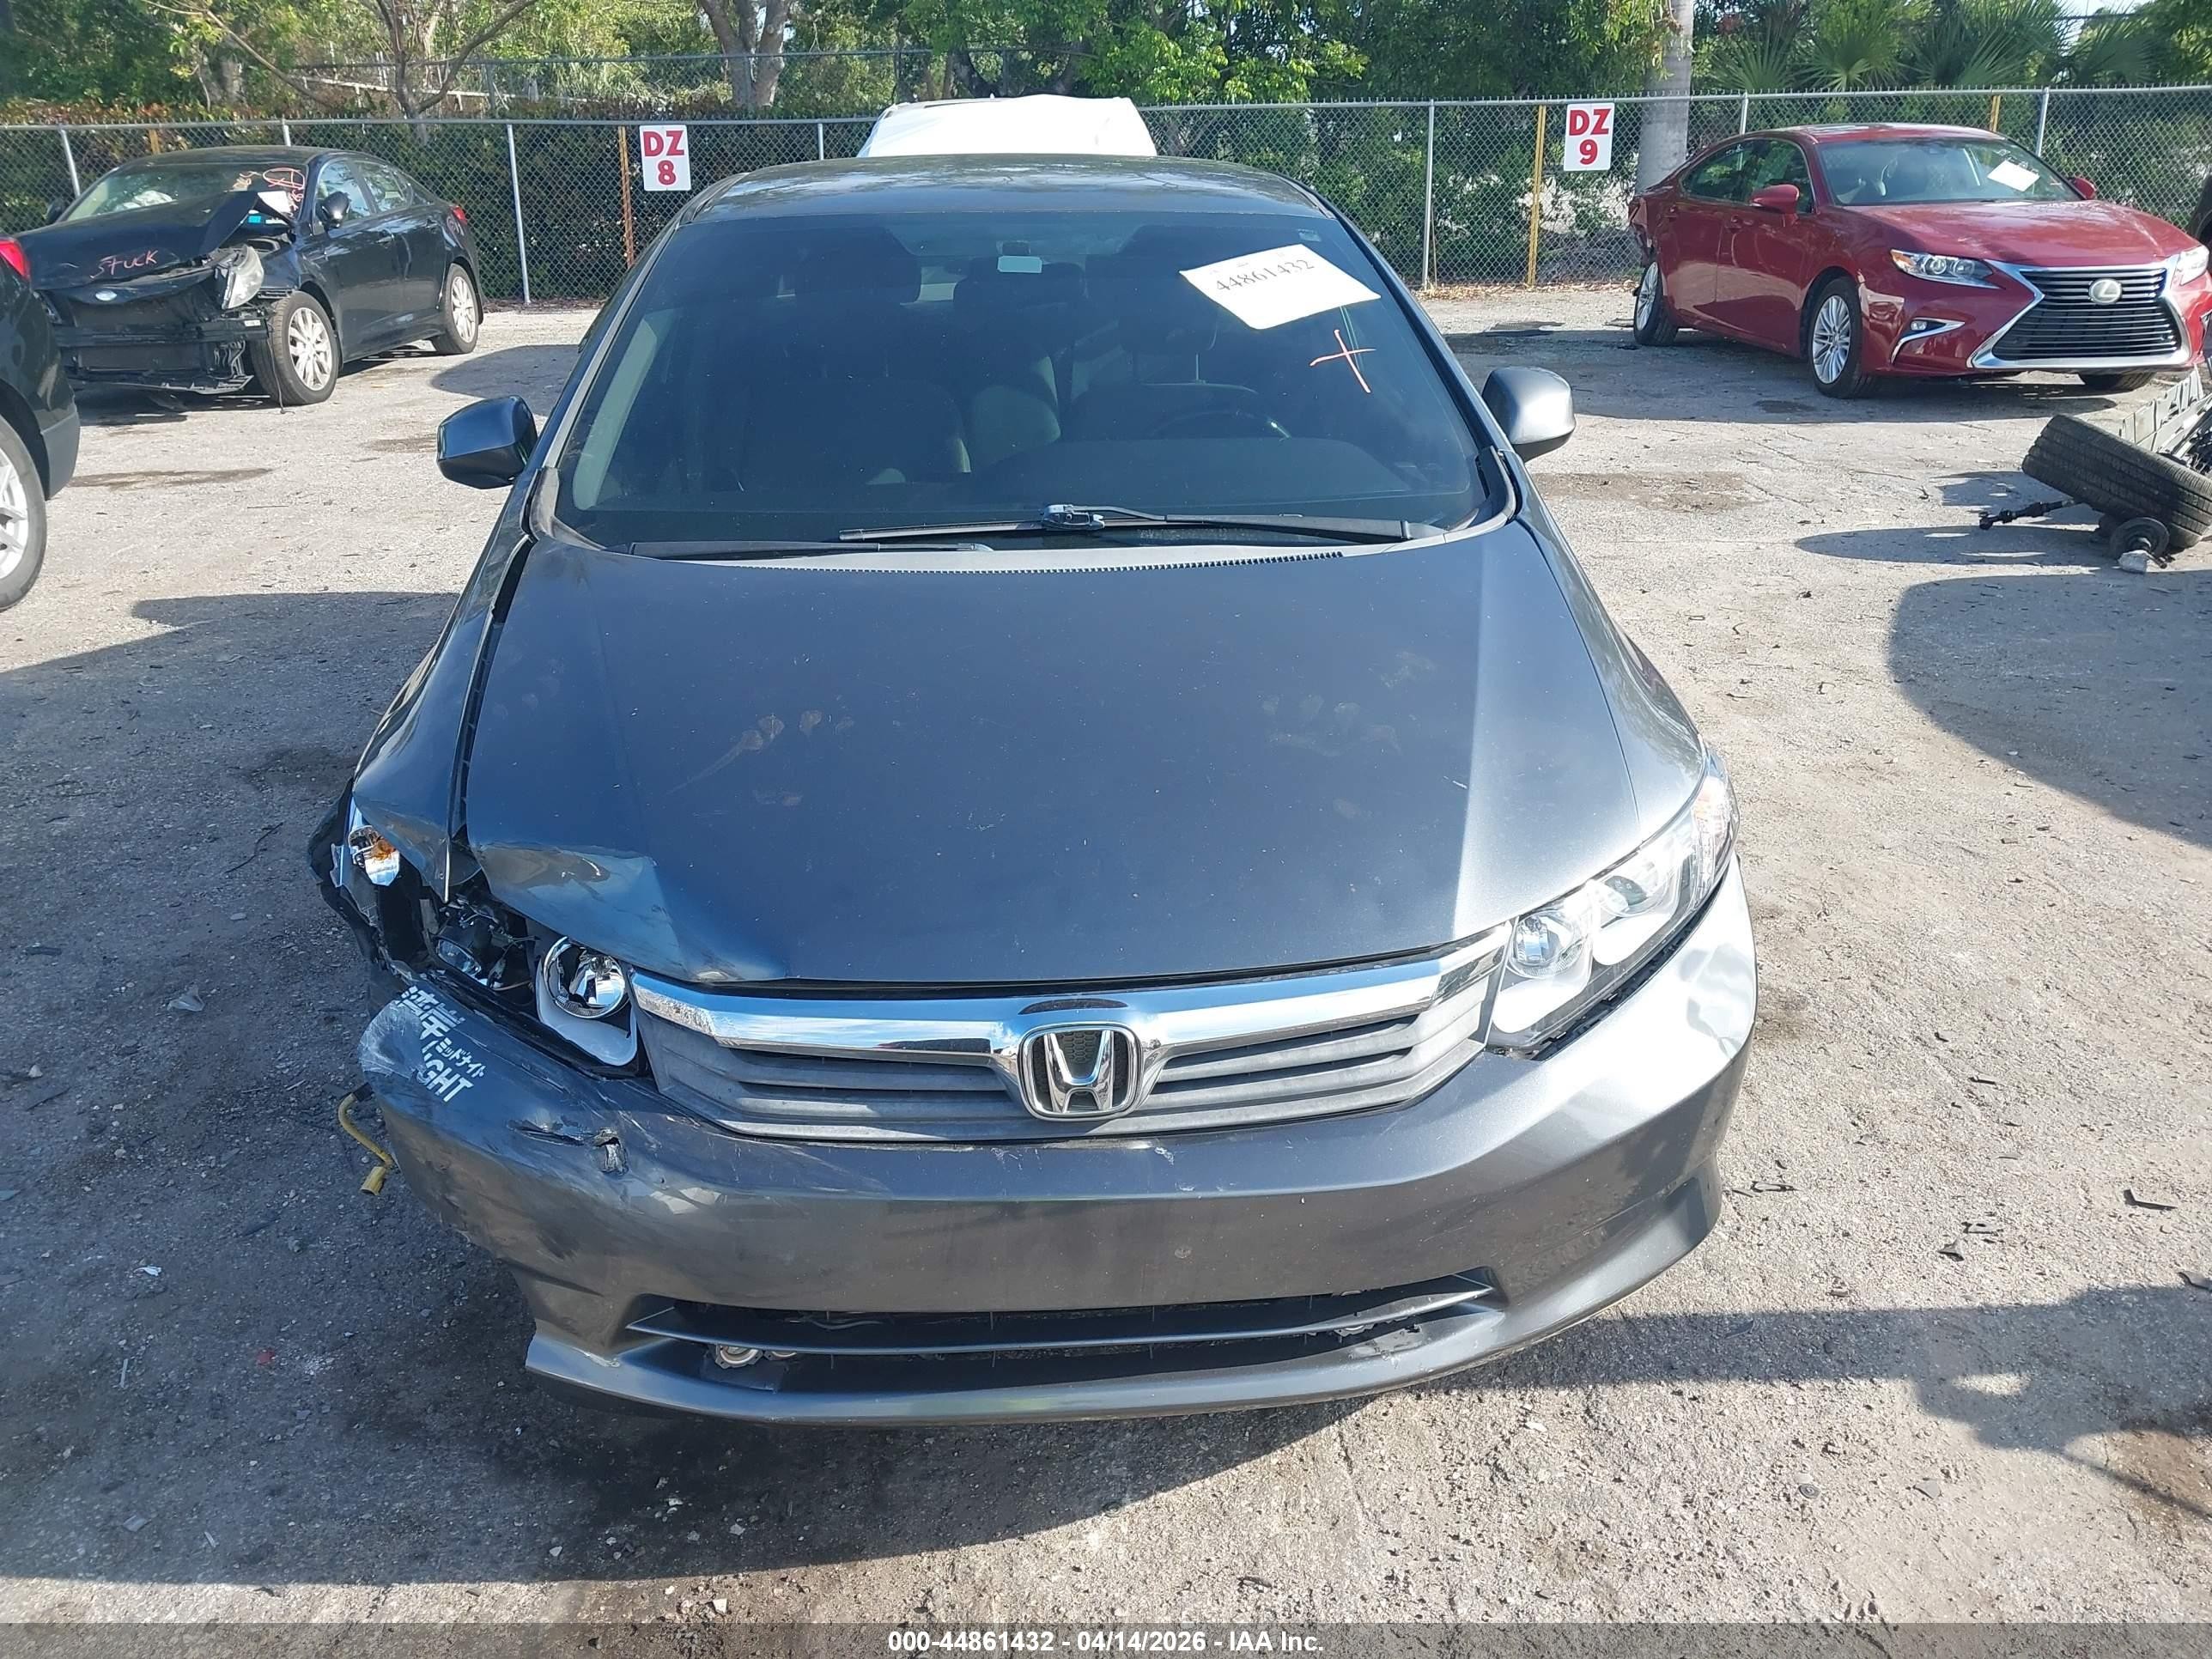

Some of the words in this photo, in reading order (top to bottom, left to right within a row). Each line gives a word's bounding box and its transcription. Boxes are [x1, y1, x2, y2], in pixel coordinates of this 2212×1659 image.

[1569, 108, 1612, 136] DZ
[643, 131, 685, 156] DZ
[1579, 139, 1598, 165] 9
[658, 160, 677, 185] 8
[1216, 259, 1315, 291] 44861432
[435, 1037, 487, 1078] ミッドナイト
